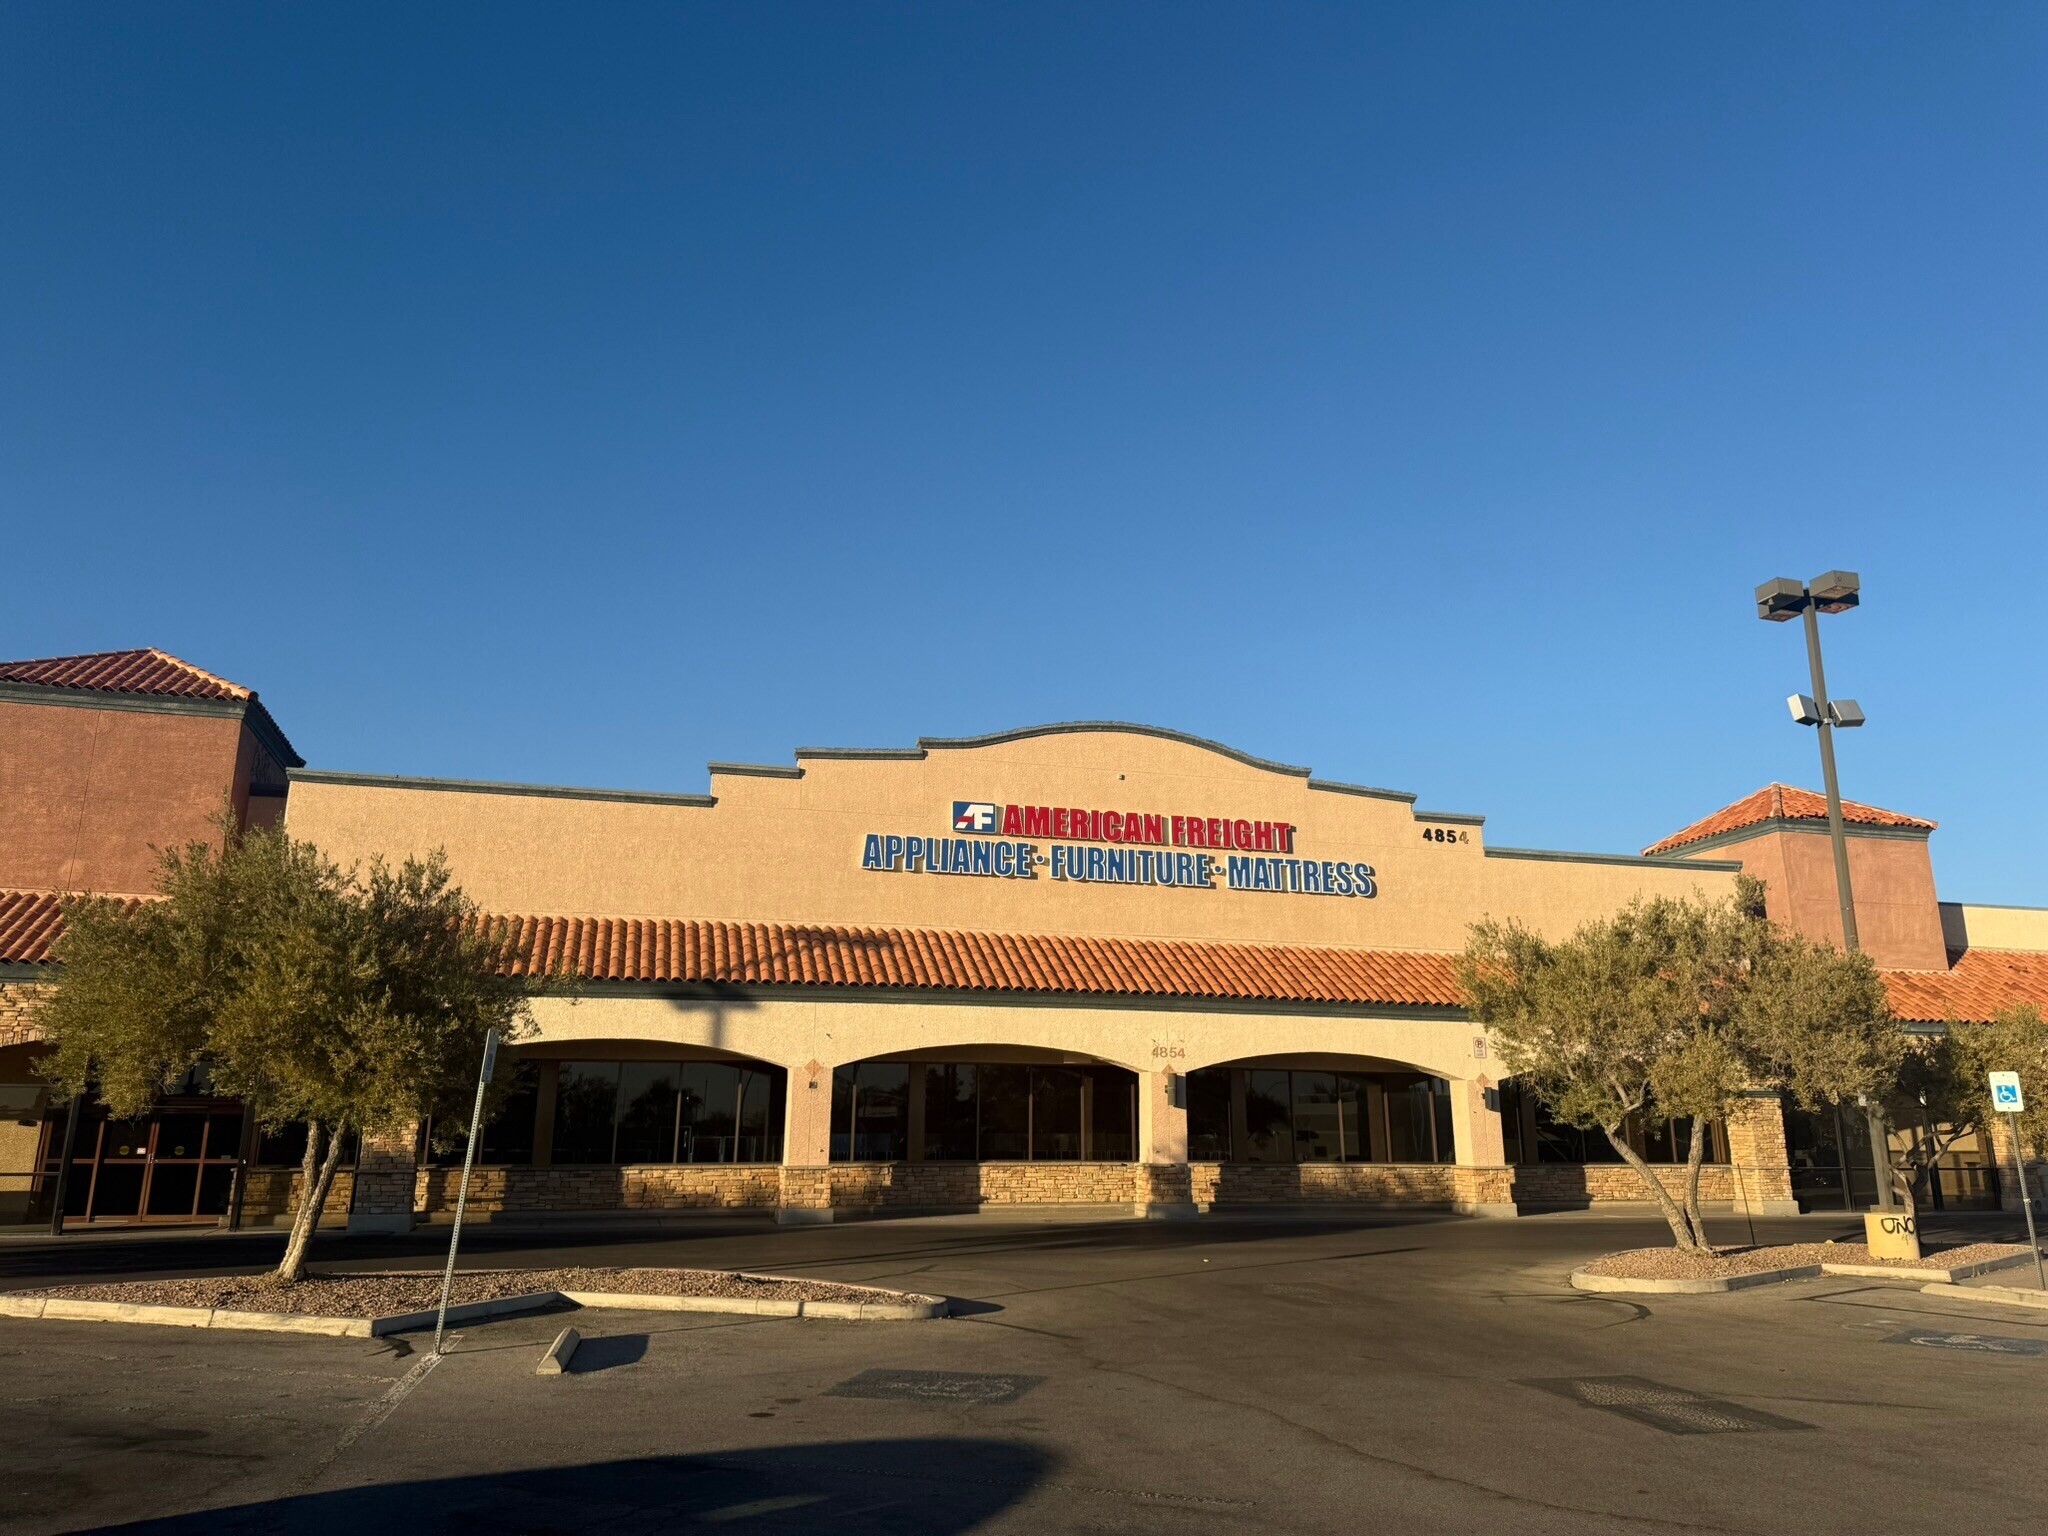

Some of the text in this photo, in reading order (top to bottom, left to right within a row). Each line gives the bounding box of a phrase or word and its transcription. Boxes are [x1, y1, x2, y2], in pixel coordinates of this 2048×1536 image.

[955, 803, 1291, 852] AF AMERICAN FREIGHT
[1422, 828, 1469, 844] 4854
[861, 834, 1373, 897] APPLIANCE FURNITURE MATTRESS
[1151, 1046, 1186, 1058] 4854
